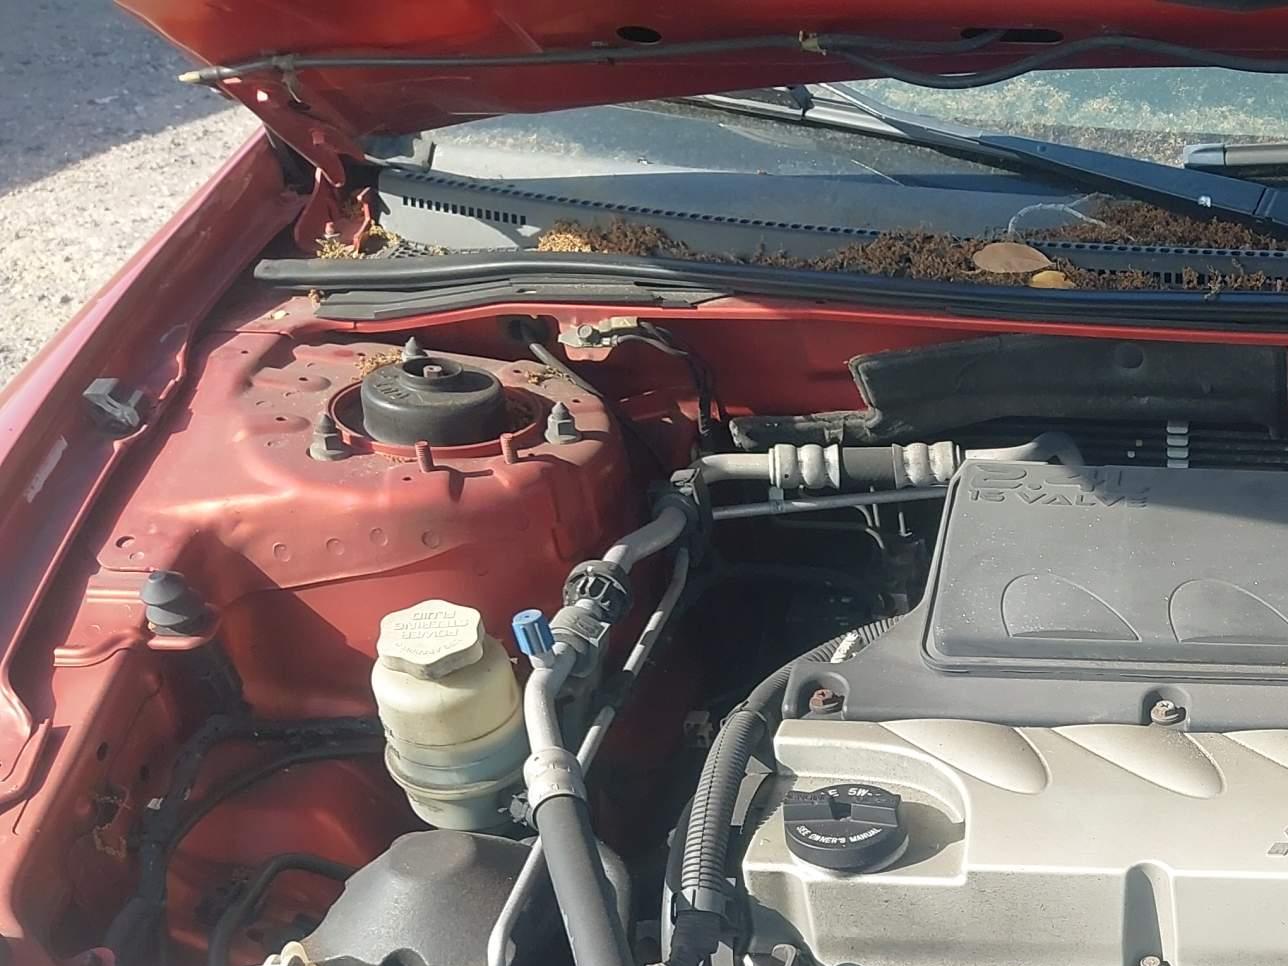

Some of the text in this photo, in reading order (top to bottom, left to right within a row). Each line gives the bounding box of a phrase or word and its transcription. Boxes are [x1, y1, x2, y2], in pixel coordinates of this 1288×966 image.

[1016, 492, 1149, 508] VALVE
[796, 825, 883, 844] SEE OWNER'S MANUAL
